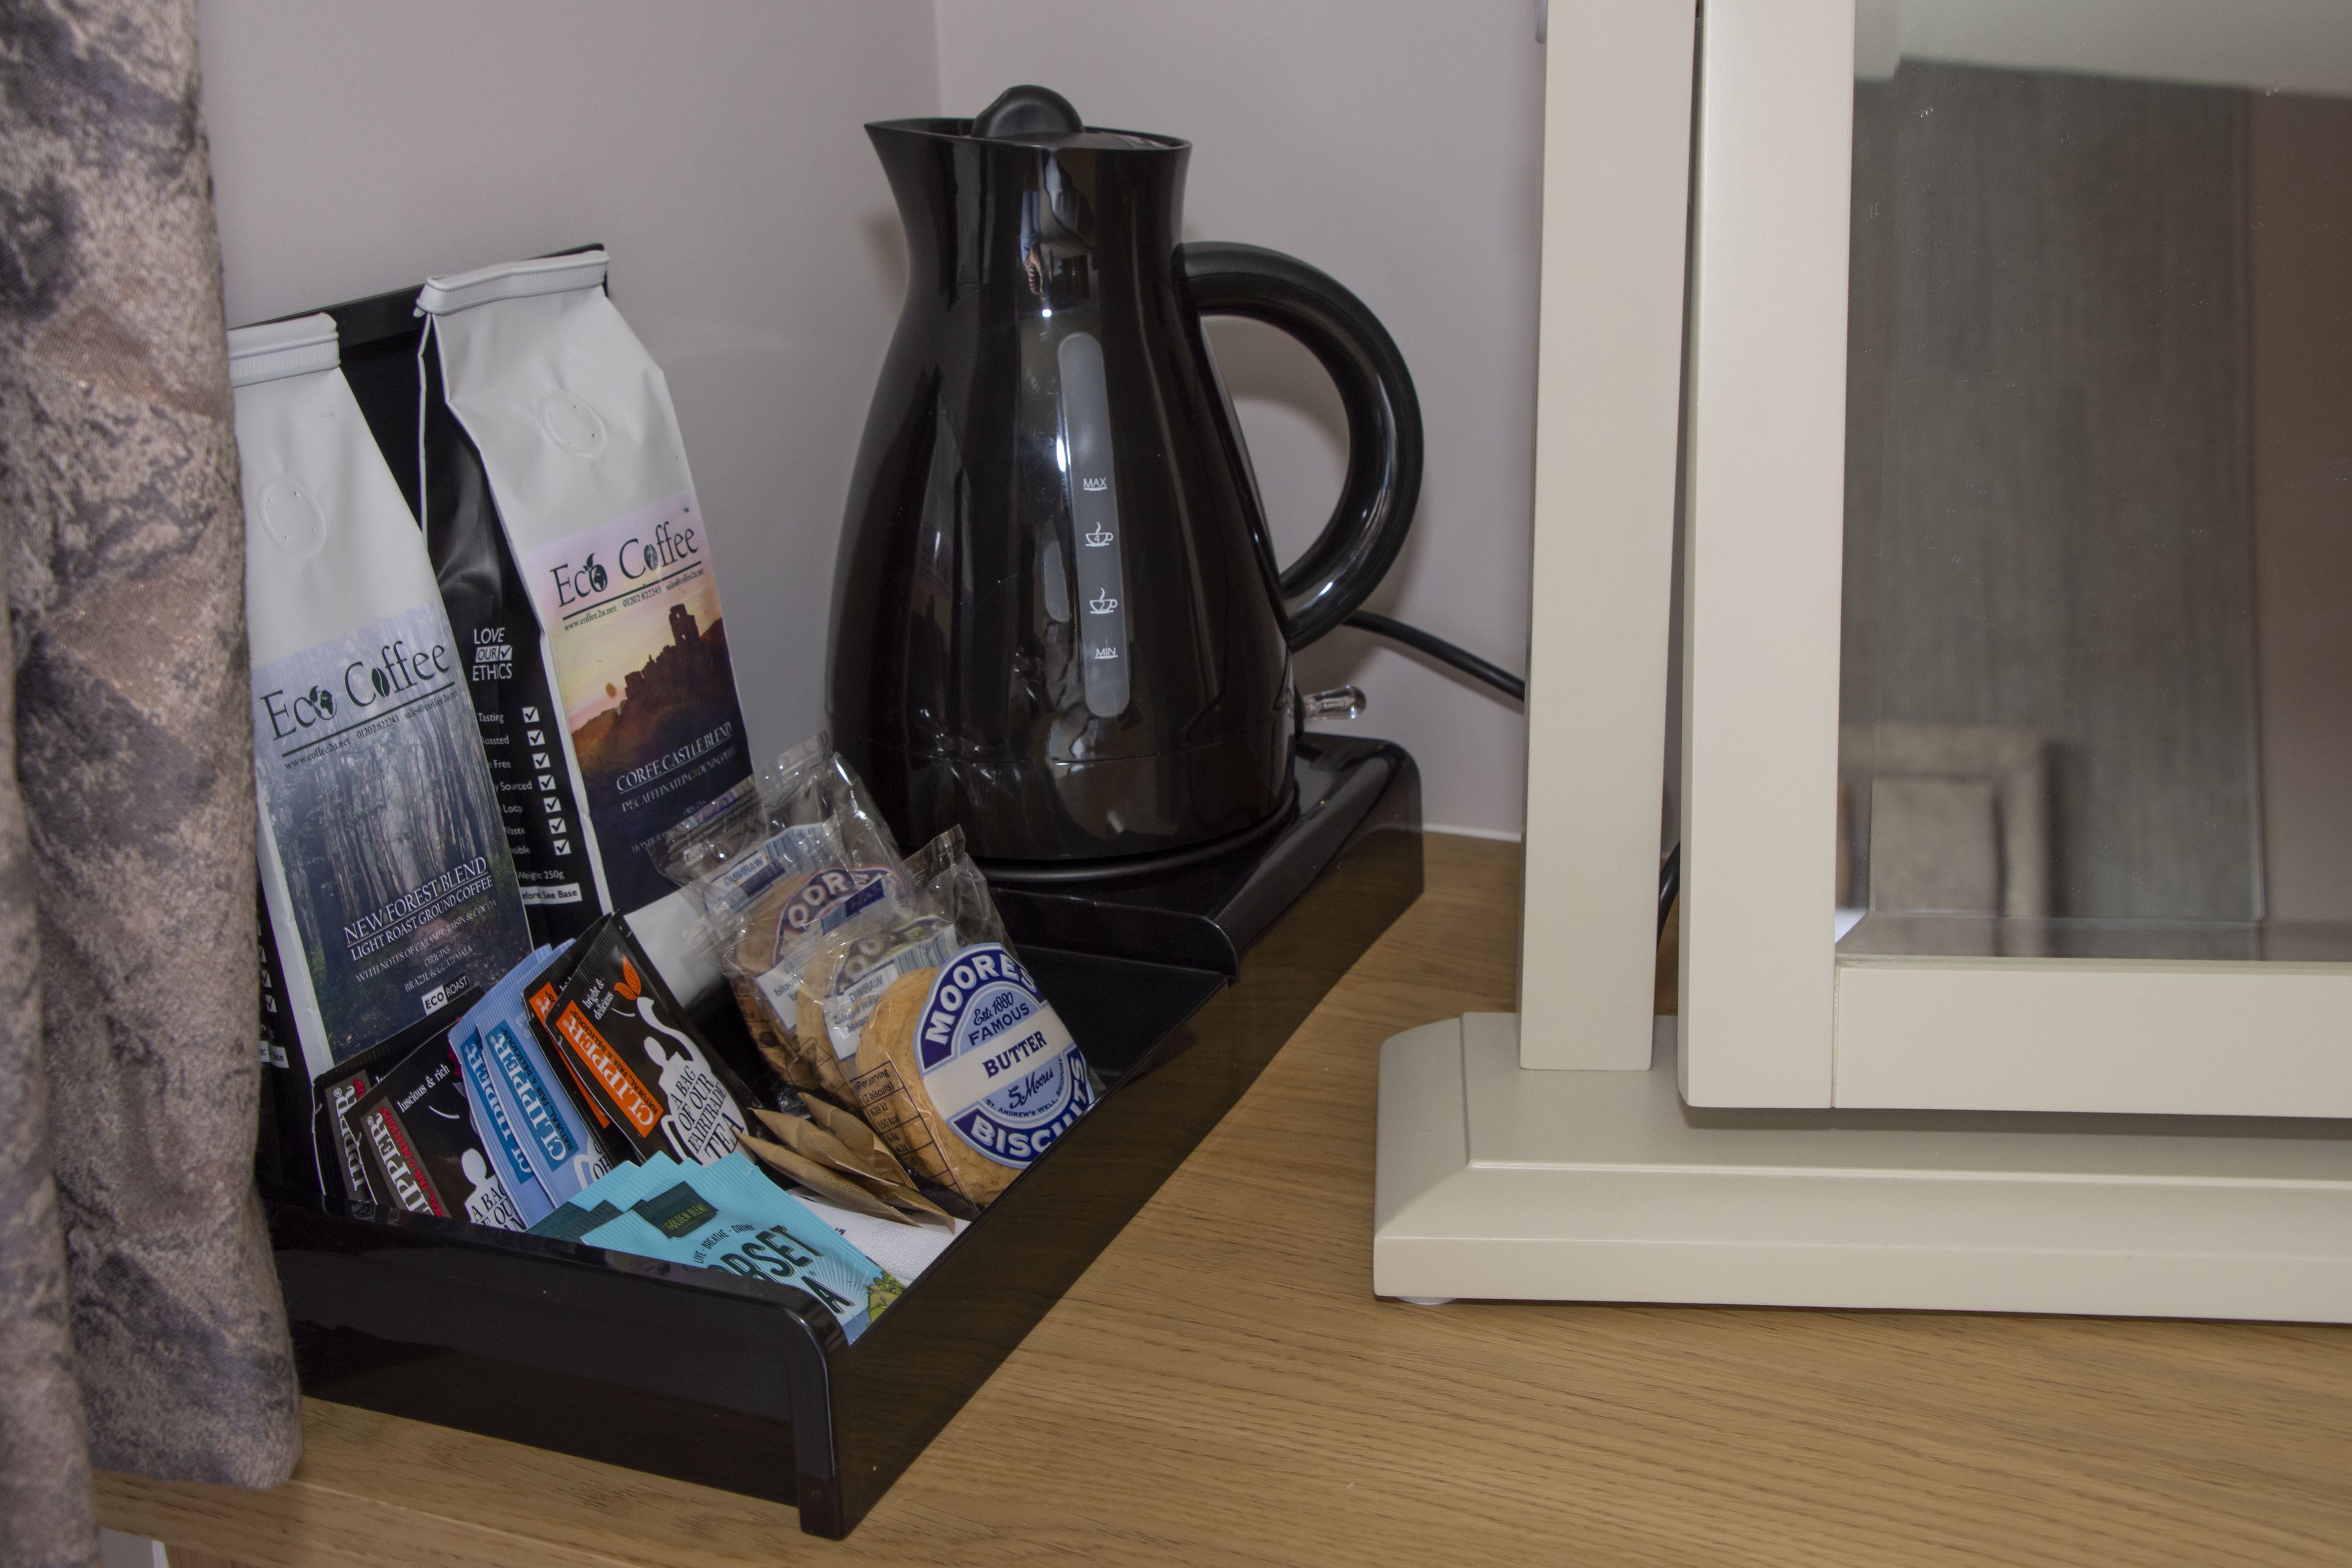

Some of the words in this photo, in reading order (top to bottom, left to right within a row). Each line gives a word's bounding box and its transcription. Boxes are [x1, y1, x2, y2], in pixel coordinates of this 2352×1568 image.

[1083, 477, 1107, 488] MAX
[550, 556, 608, 608] Eco
[619, 521, 699, 579] Coffee
[564, 605, 617, 632] www.coffee2u.net
[622, 593, 641, 608] 01202
[641, 586, 662, 602] 822243
[473, 627, 505, 644] LOVE
[477, 647, 498, 661] OUR
[1095, 647, 1117, 657] MIN
[472, 663, 513, 681] ETHICS
[260, 686, 337, 741] Eco
[344, 641, 451, 707] Coffee
[284, 738, 352, 771] www.coffee2u.net
[356, 725, 377, 740] 01202
[377, 714, 401, 731] 822243
[404, 690, 459, 720] sales@coffee2u.net
[477, 712, 505, 724] Tasting
[494, 760, 512, 769] Free
[616, 759, 663, 792] CORFE
[662, 737, 704, 771] CASTLE
[704, 721, 733, 750] BLEND
[500, 780, 533, 791] Sourced
[502, 804, 523, 815] Loop
[544, 870, 565, 881] 250g
[343, 909, 383, 945] NEW
[385, 879, 439, 923] FOREST
[439, 856, 487, 893] BLEND
[522, 891, 542, 900] efore
[543, 891, 556, 900] See
[557, 889, 578, 899] Base
[350, 933, 385, 962] LIGHT
[385, 917, 418, 944] ROAST
[418, 894, 456, 925] GROUND
[456, 875, 494, 903] COFFEE
[355, 966, 382, 982] WITH
[380, 951, 405, 970] NOTES
[404, 948, 415, 959] OF
[404, 972, 431, 993] BRAZIL
[431, 968, 438, 978] &
[436, 945, 473, 974] GUATEMALA
[424, 945, 451, 967] ORIGINS
[423, 992, 445, 1011] ECO
[445, 974, 469, 998] ROAST
[582, 988, 601, 1009] bright
[593, 990, 614, 1021] delicious
[992, 991, 1014, 1016] 1880
[968, 1003, 1030, 1047] FAMOUS
[982, 1030, 1048, 1079] BUTTER
[569, 1016, 654, 1126] CLIPPER
[675, 1064, 696, 1098] BAG
[857, 1079, 869, 1090] Per
[869, 1068, 890, 1085] serving
[1056, 1057, 1065, 1097] BRIDPORT
[397, 1084, 428, 1114] luscious
[425, 1075, 435, 1089] &
[434, 1063, 451, 1082] rich
[494, 1031, 567, 1162] CLIPPER
[670, 1093, 682, 1110] A
[677, 1102, 696, 1131] OF
[688, 1073, 715, 1110] OUR
[870, 1081, 895, 1100] biscuits)
[687, 1082, 728, 1155] FAIRTRADE
[888, 1112, 900, 1125] kcal
[470, 1205, 484, 1224] A
[663, 1209, 692, 1231] GOLDEN
[686, 1202, 709, 1217] BLEND
[693, 1250, 707, 1265] LIVE
[701, 1229, 730, 1250] BREATHE
[731, 1223, 758, 1234] DRINK
